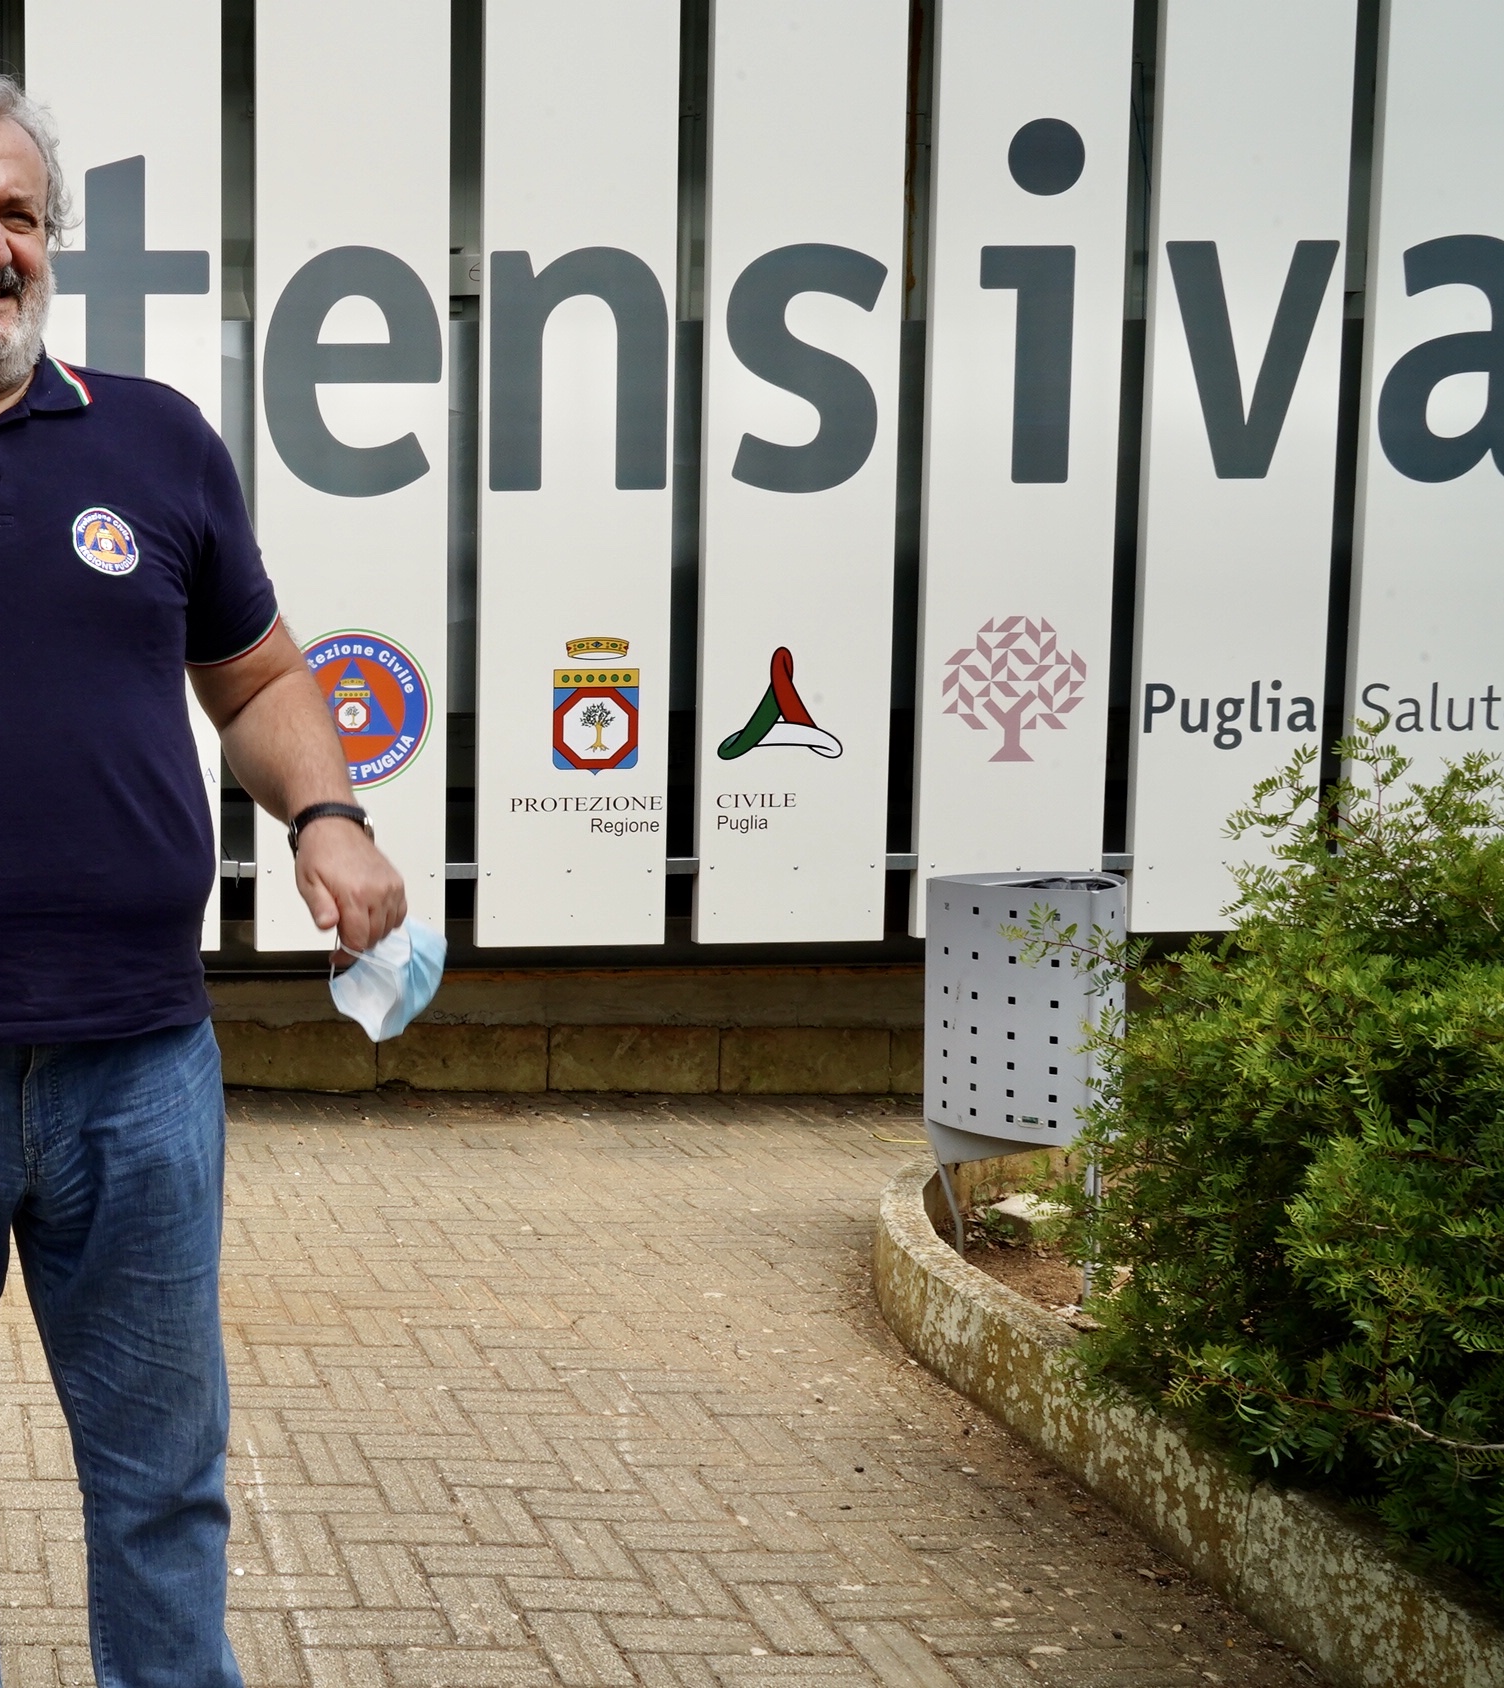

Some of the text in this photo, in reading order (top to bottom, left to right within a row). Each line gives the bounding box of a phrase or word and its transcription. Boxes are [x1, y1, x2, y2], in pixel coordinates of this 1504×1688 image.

[112, 520, 130, 541] Civile
[78, 545, 135, 571] REGIONE PUGLIA
[307, 643, 414, 694] tezione Civile
[1143, 679, 1317, 750] Puglia
[360, 734, 415, 778] PUGLIA
[509, 793, 797, 812] PROTEZIONE CIVILE
[590, 814, 768, 836] Regione Puglia
